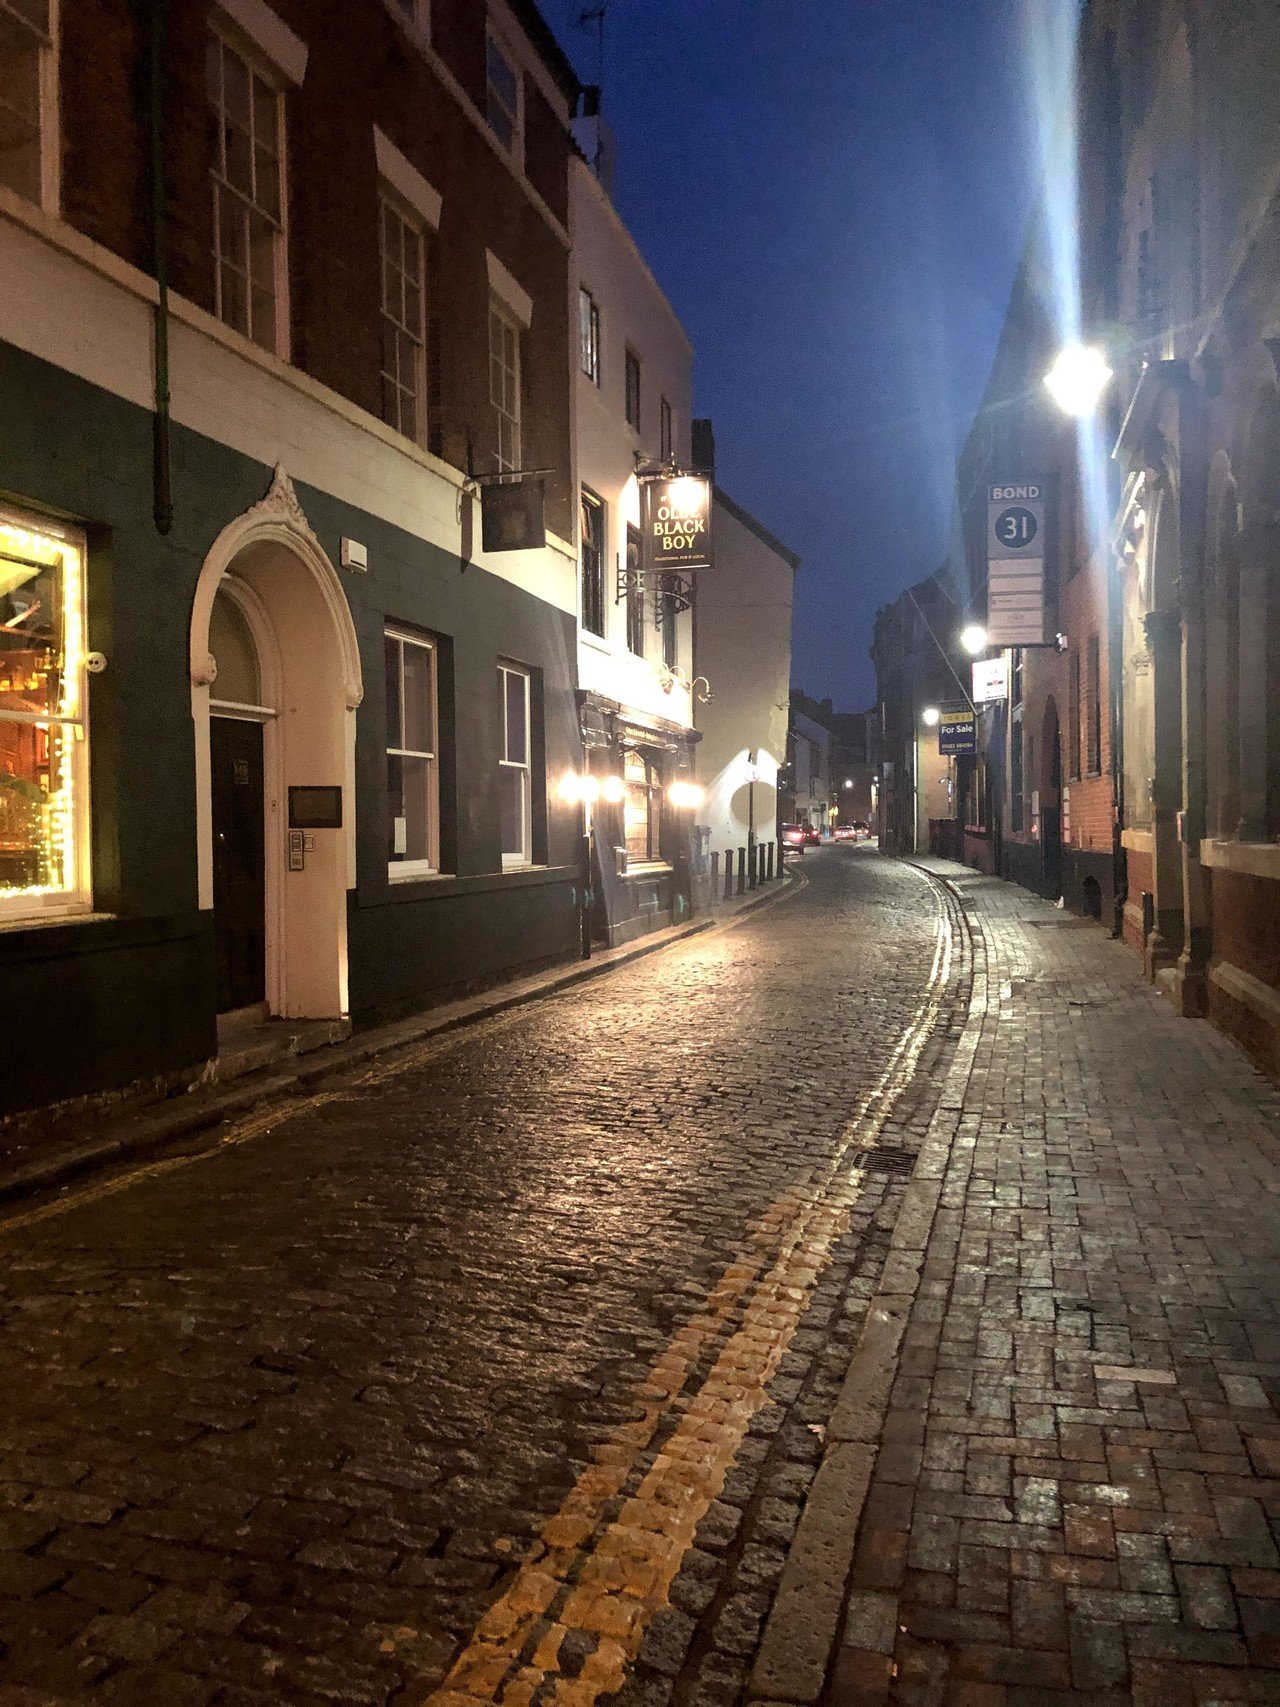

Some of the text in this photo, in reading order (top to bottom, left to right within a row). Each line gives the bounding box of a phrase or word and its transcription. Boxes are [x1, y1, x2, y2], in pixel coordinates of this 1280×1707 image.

[993, 486, 1039, 499] BOND
[653, 519, 705, 536] BLACK
[1004, 516, 1028, 539] 31
[663, 535, 696, 550] BOY
[941, 725, 973, 734] For Sale
